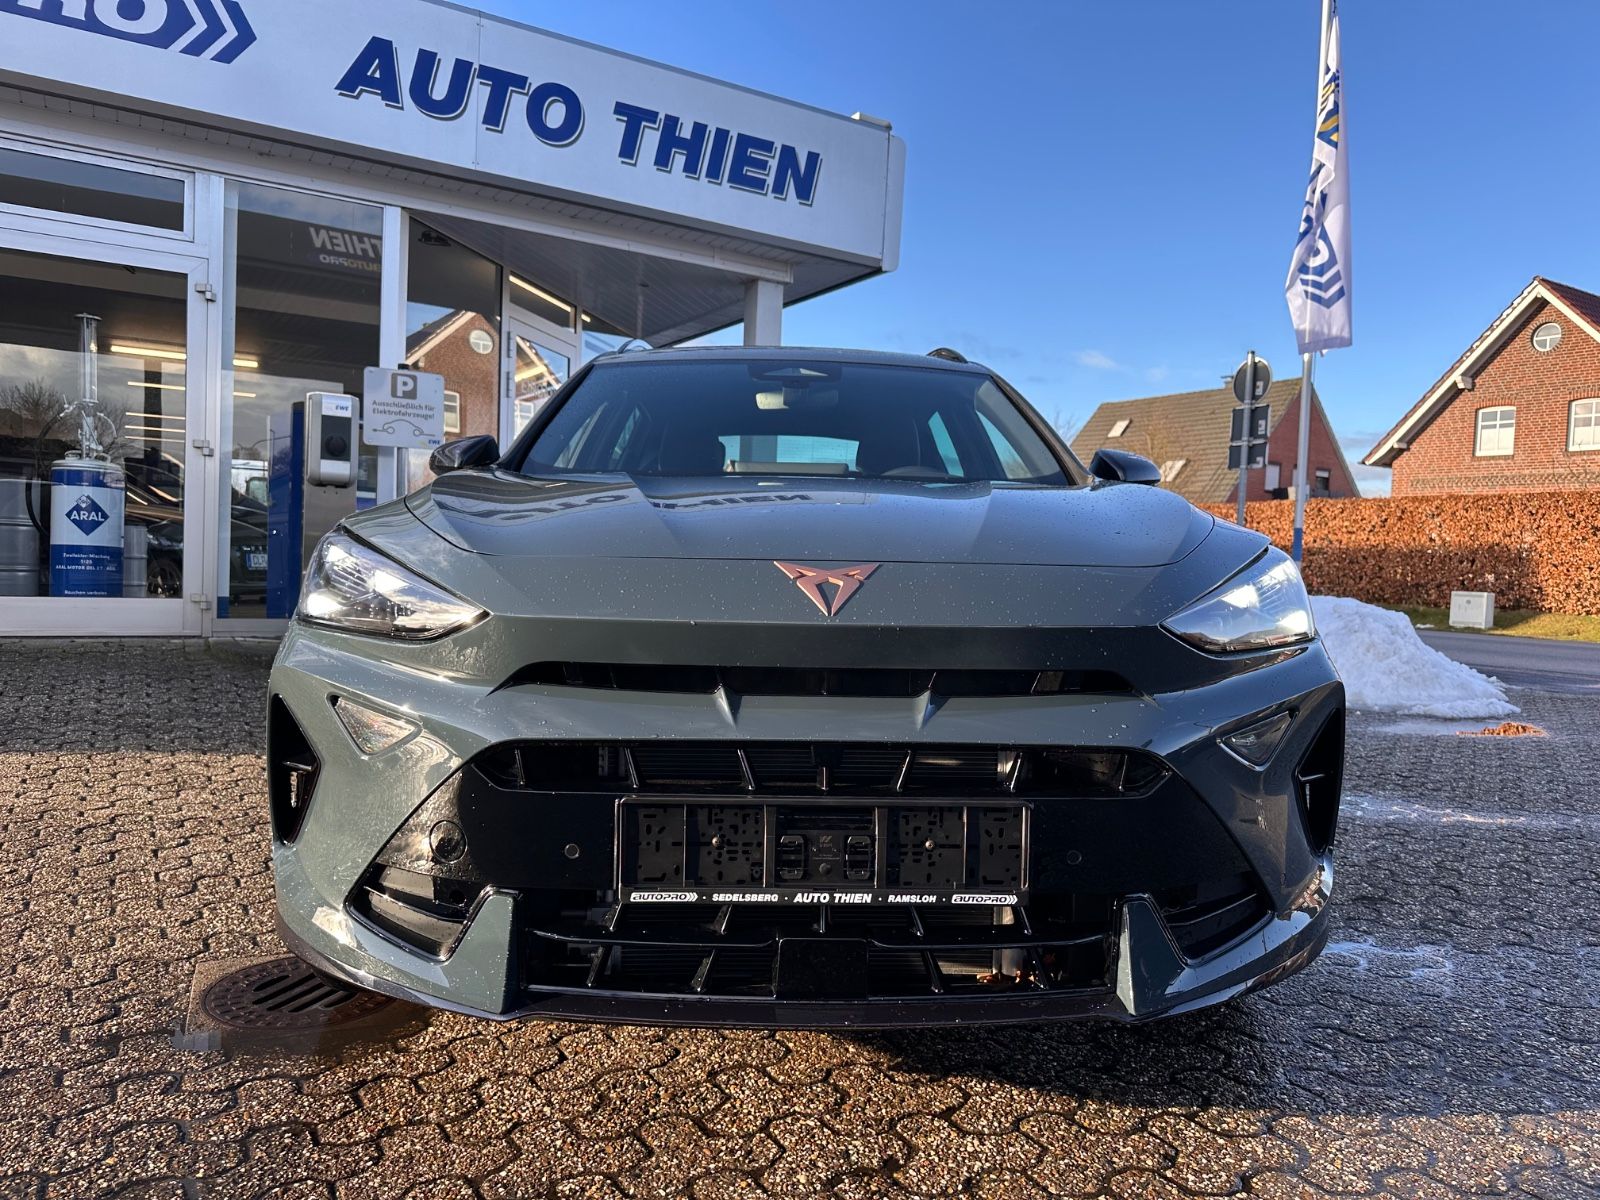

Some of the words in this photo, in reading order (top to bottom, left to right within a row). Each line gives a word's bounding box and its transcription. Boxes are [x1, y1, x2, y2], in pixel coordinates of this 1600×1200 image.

[334, 36, 584, 146] AUTO
[613, 101, 822, 206] THIEN
[396, 375, 415, 397] P
[372, 400, 424, 411] Ausschließlich
[424, 404, 436, 412] für
[70, 510, 105, 522] ARAL
[712, 893, 779, 902] SEDELSBERG
[793, 892, 829, 903] AUTO
[833, 893, 873, 904] THIEN
[887, 894, 937, 903] RAMSLOH
